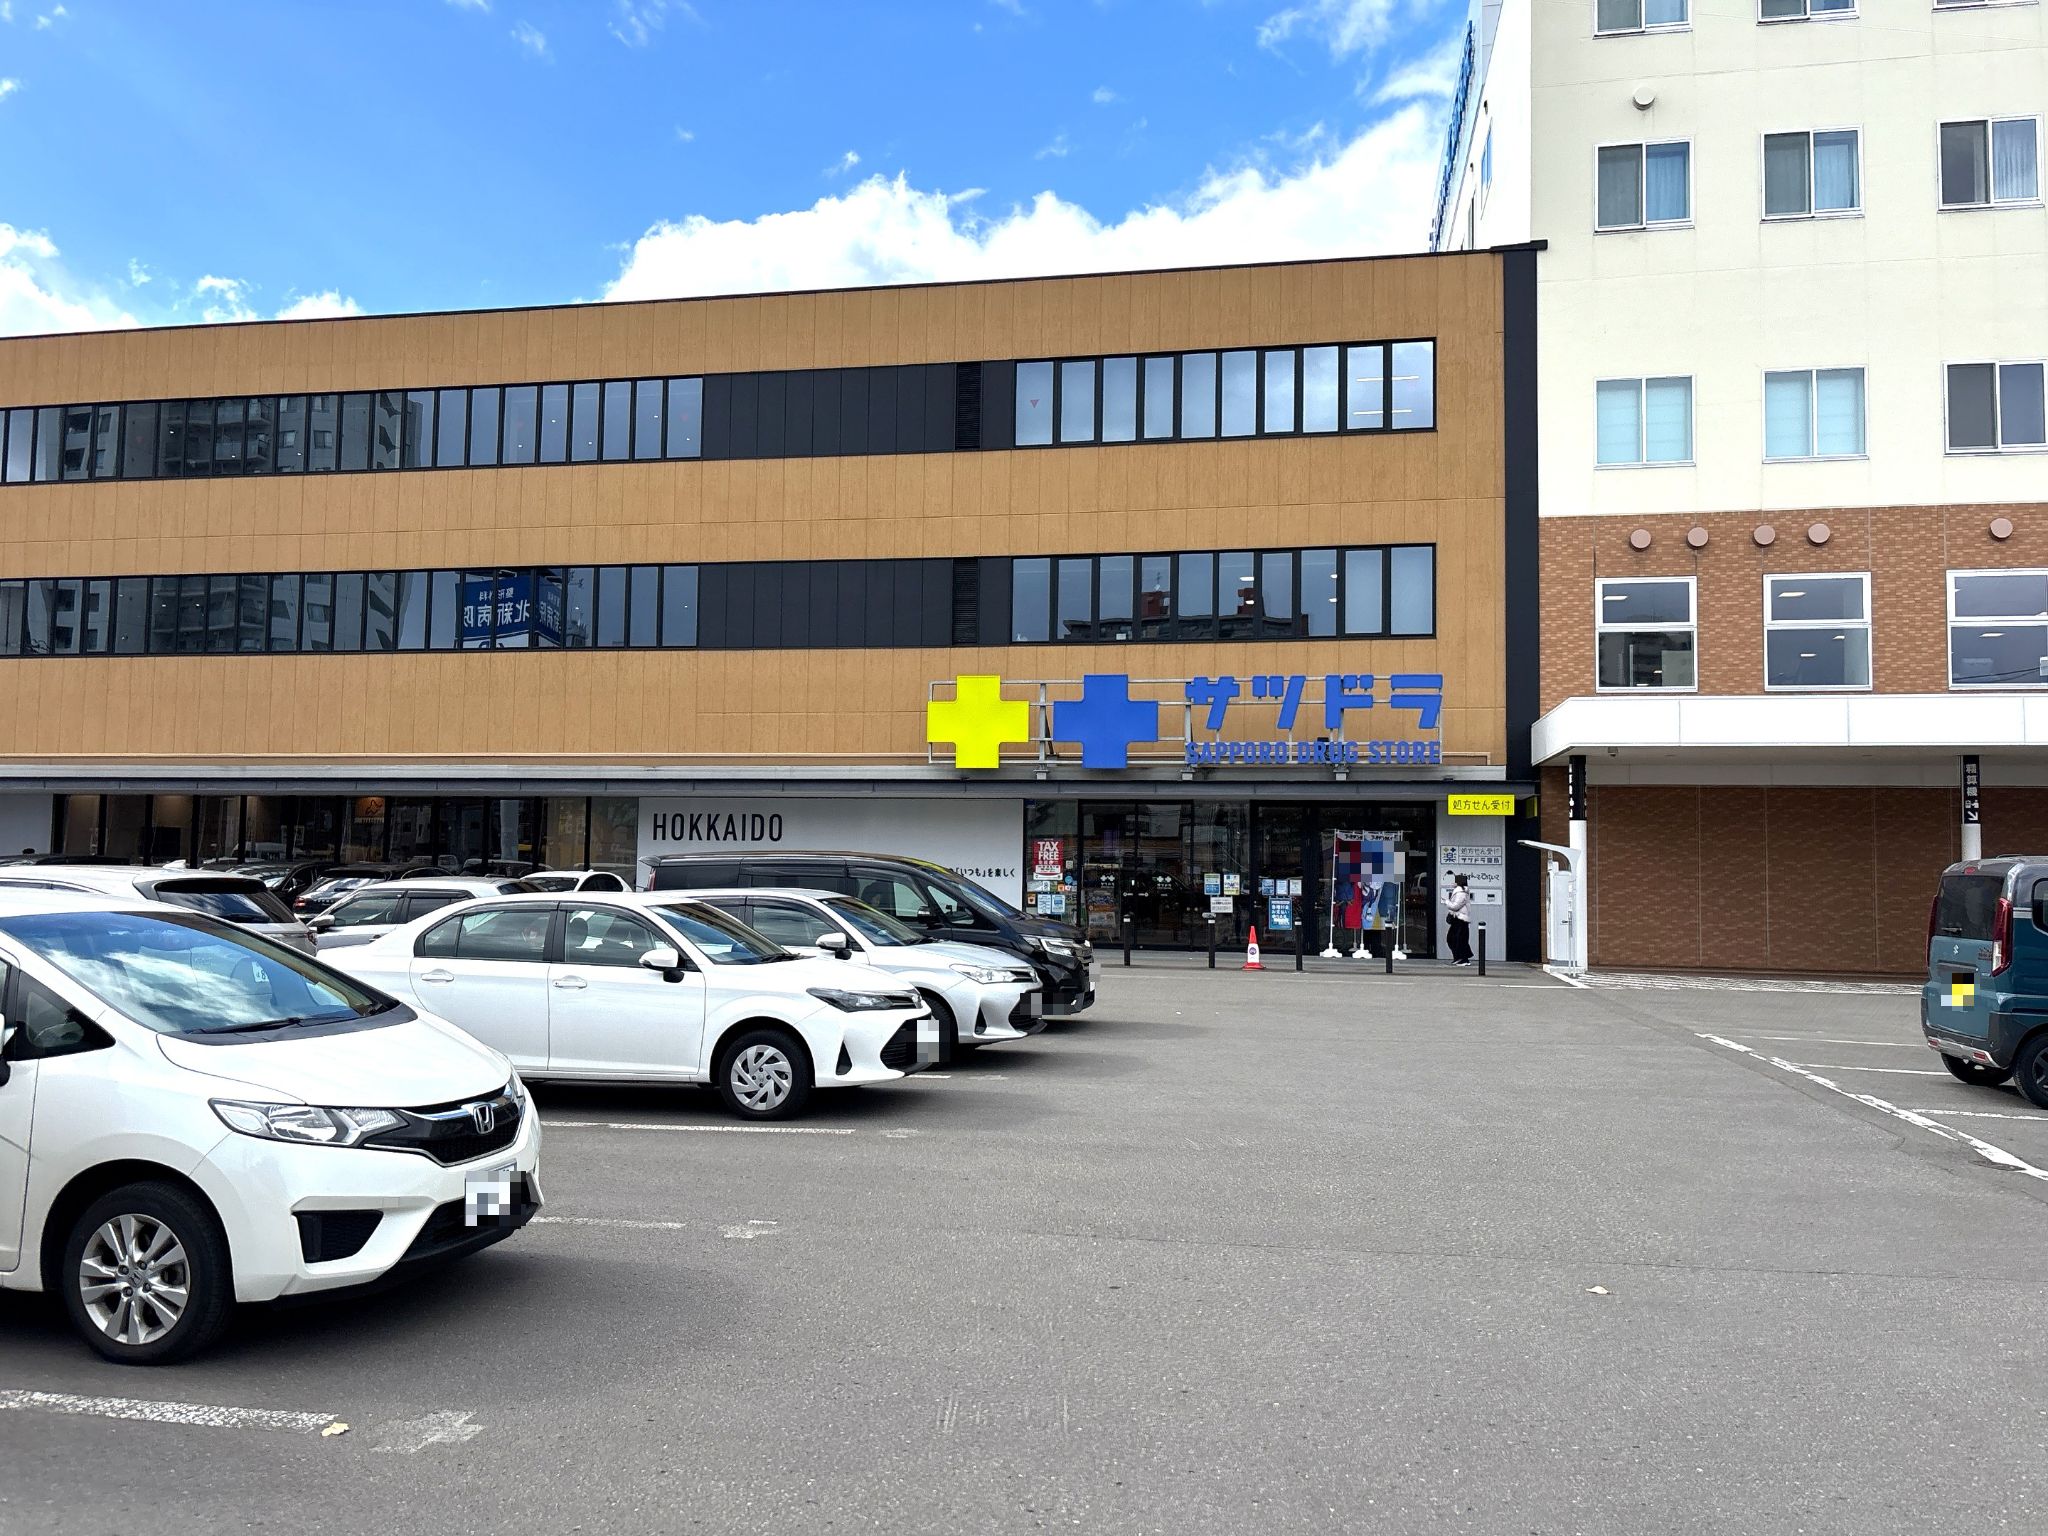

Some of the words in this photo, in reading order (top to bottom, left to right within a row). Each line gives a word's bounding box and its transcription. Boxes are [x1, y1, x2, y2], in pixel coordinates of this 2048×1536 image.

[1185, 674, 1443, 729] サツドラ
[1186, 741, 1289, 764] SAPPORO
[1298, 741, 1359, 764] DRUG
[1367, 741, 1441, 764] STORE
[1452, 799, 1510, 811] 処方せん受付
[652, 813, 783, 842] HOKKAIDO
[1037, 841, 1059, 851] TAX
[1038, 851, 1059, 860] FREE
